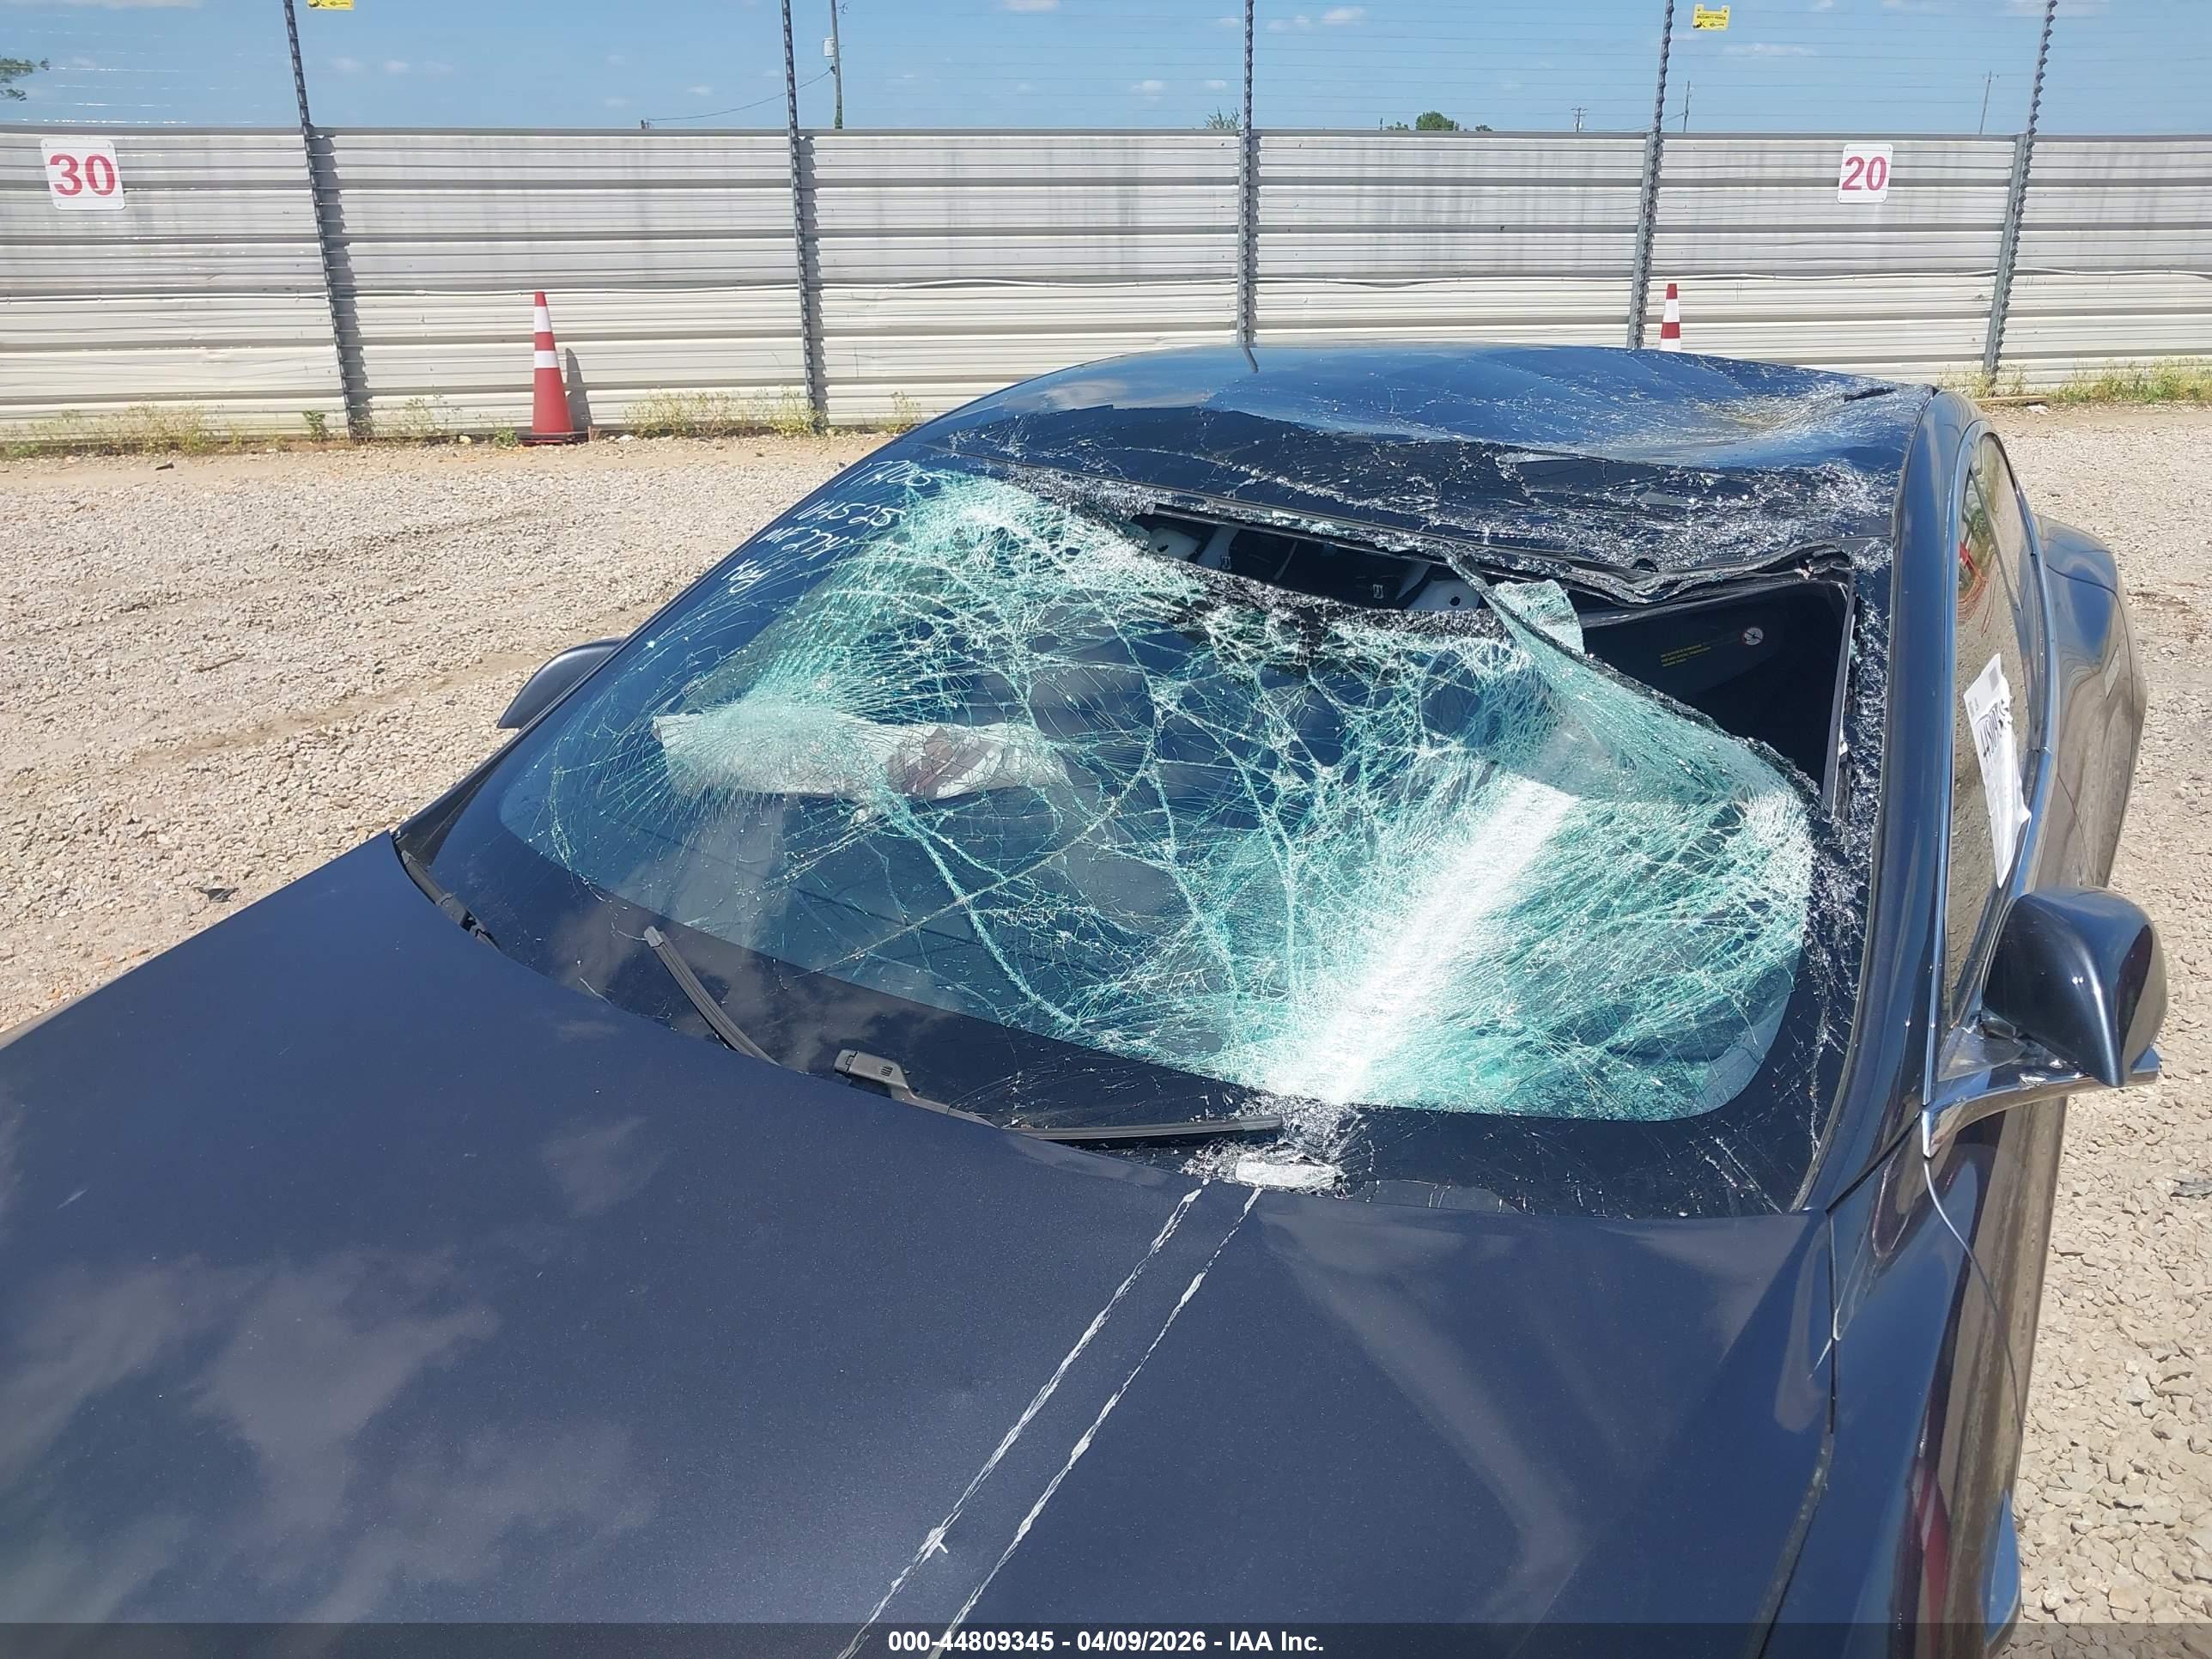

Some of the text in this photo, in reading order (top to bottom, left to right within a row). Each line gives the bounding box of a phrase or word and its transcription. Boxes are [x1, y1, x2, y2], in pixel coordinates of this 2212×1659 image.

[50, 155, 115, 196] 30
[1842, 156, 1887, 191] 20
[721, 559, 770, 593] Key
